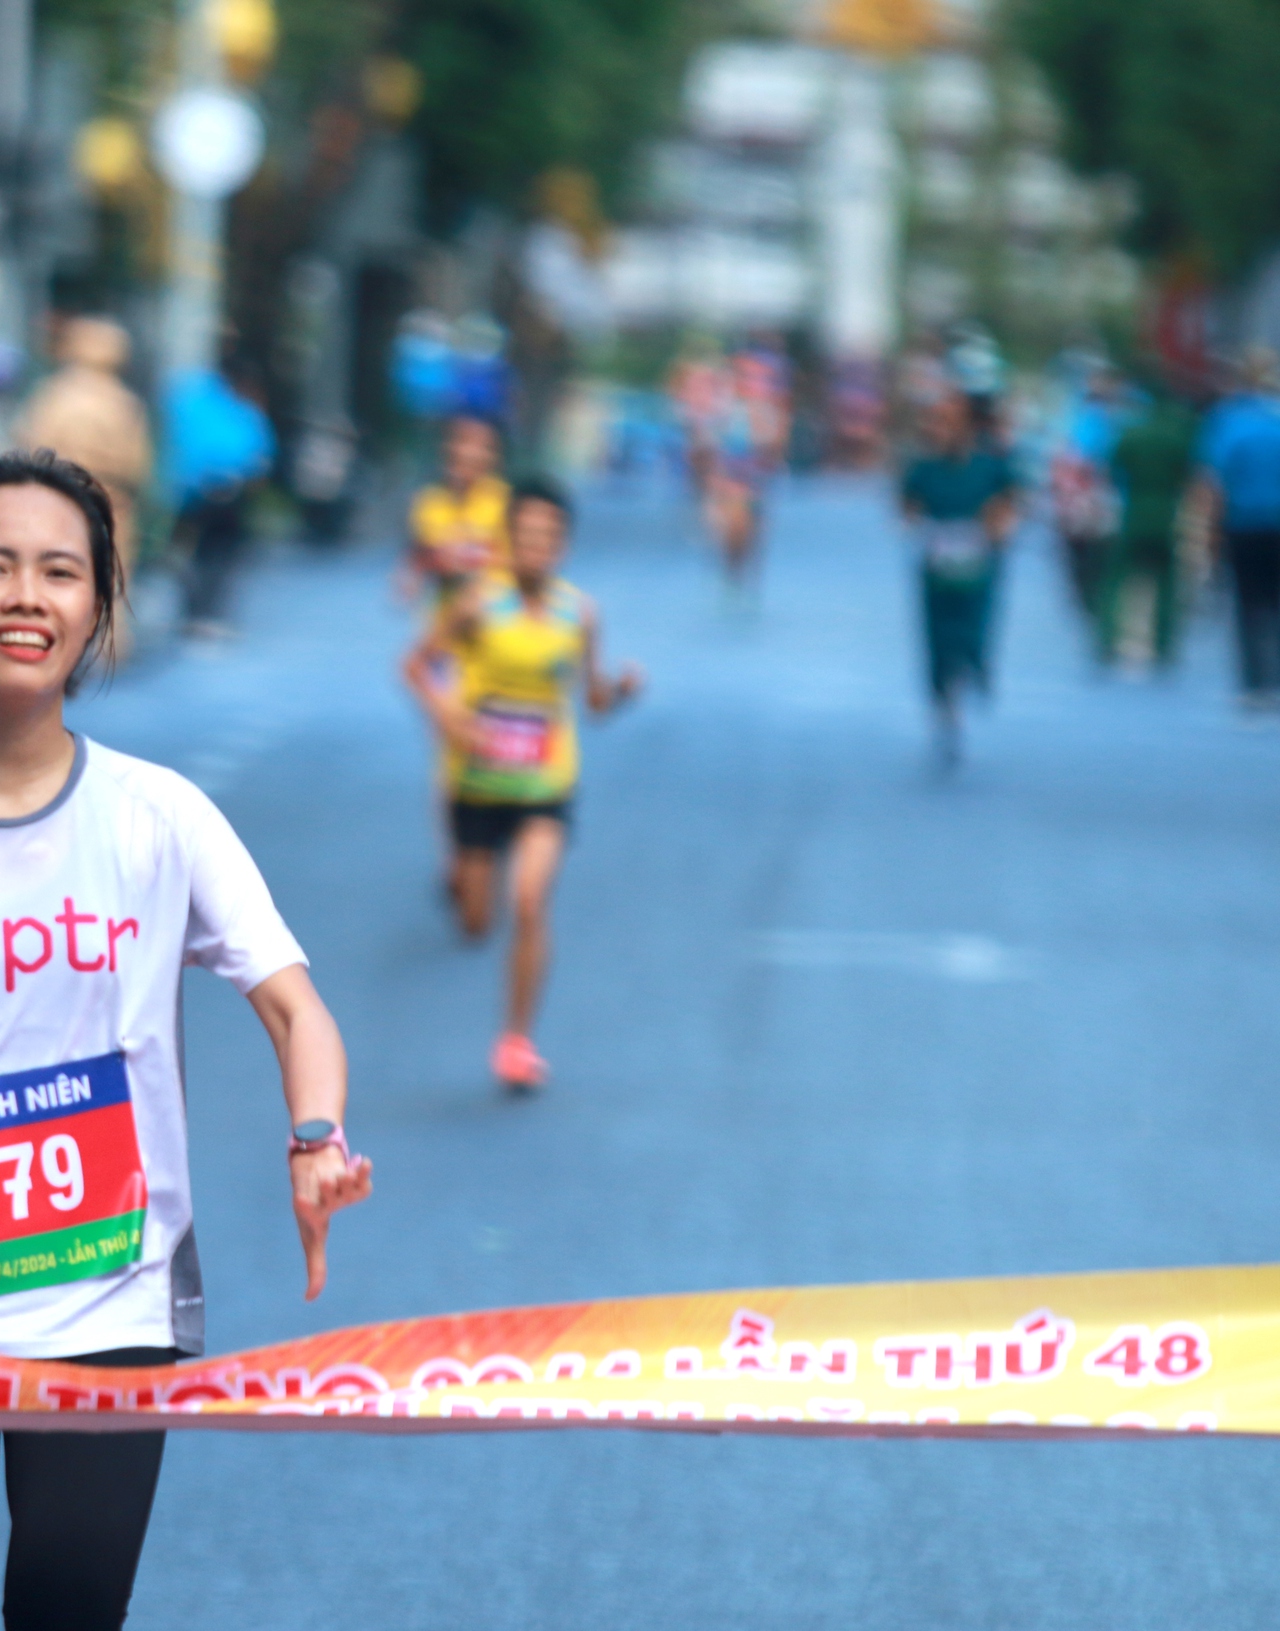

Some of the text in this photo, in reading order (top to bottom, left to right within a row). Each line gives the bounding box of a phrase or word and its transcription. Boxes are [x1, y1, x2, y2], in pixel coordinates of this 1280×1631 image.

[3, 896, 139, 993] ptr
[24, 1073, 92, 1112] NIÊN
[880, 1312, 1070, 1384] THỨ
[1089, 1328, 1207, 1381] 48
